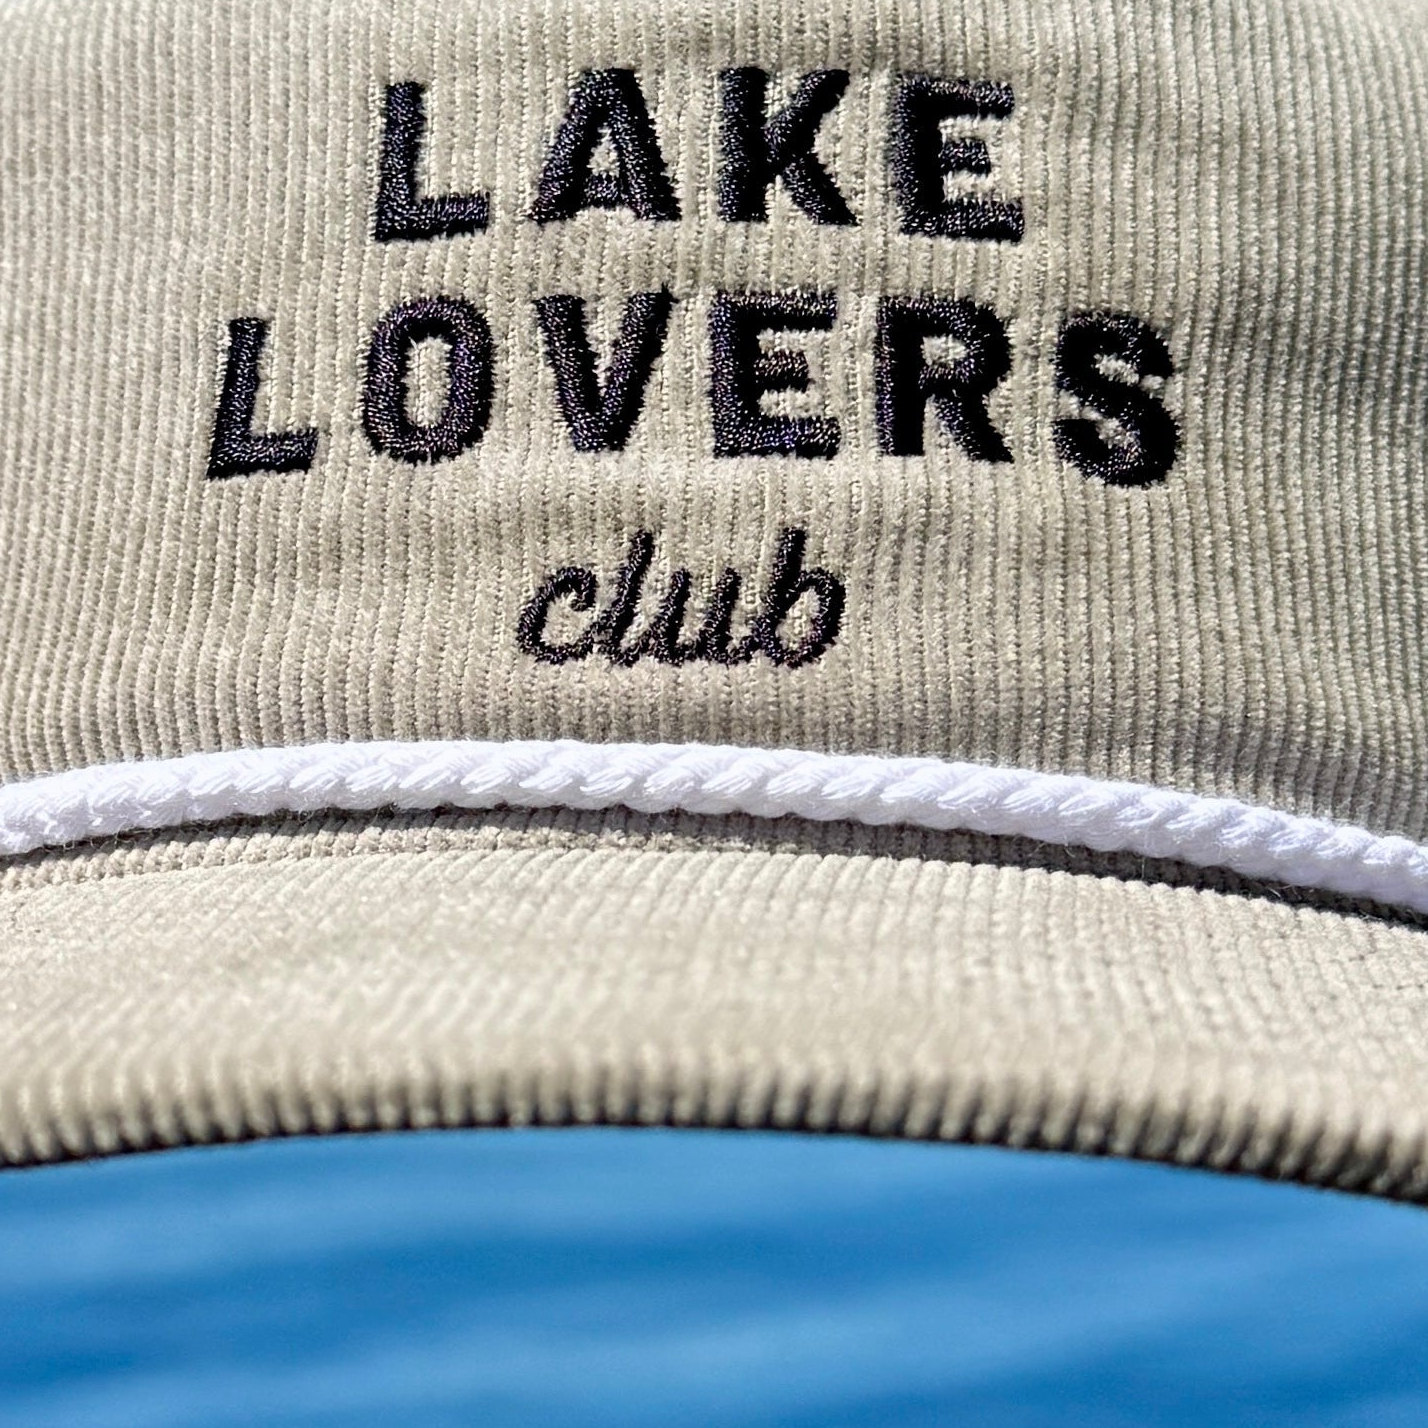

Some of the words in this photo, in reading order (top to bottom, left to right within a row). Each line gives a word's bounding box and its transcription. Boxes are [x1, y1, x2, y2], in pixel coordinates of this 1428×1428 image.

[371, 65, 1026, 245] LAKE
[204, 283, 1184, 489] LOVERS
[516, 526, 847, 671] club
